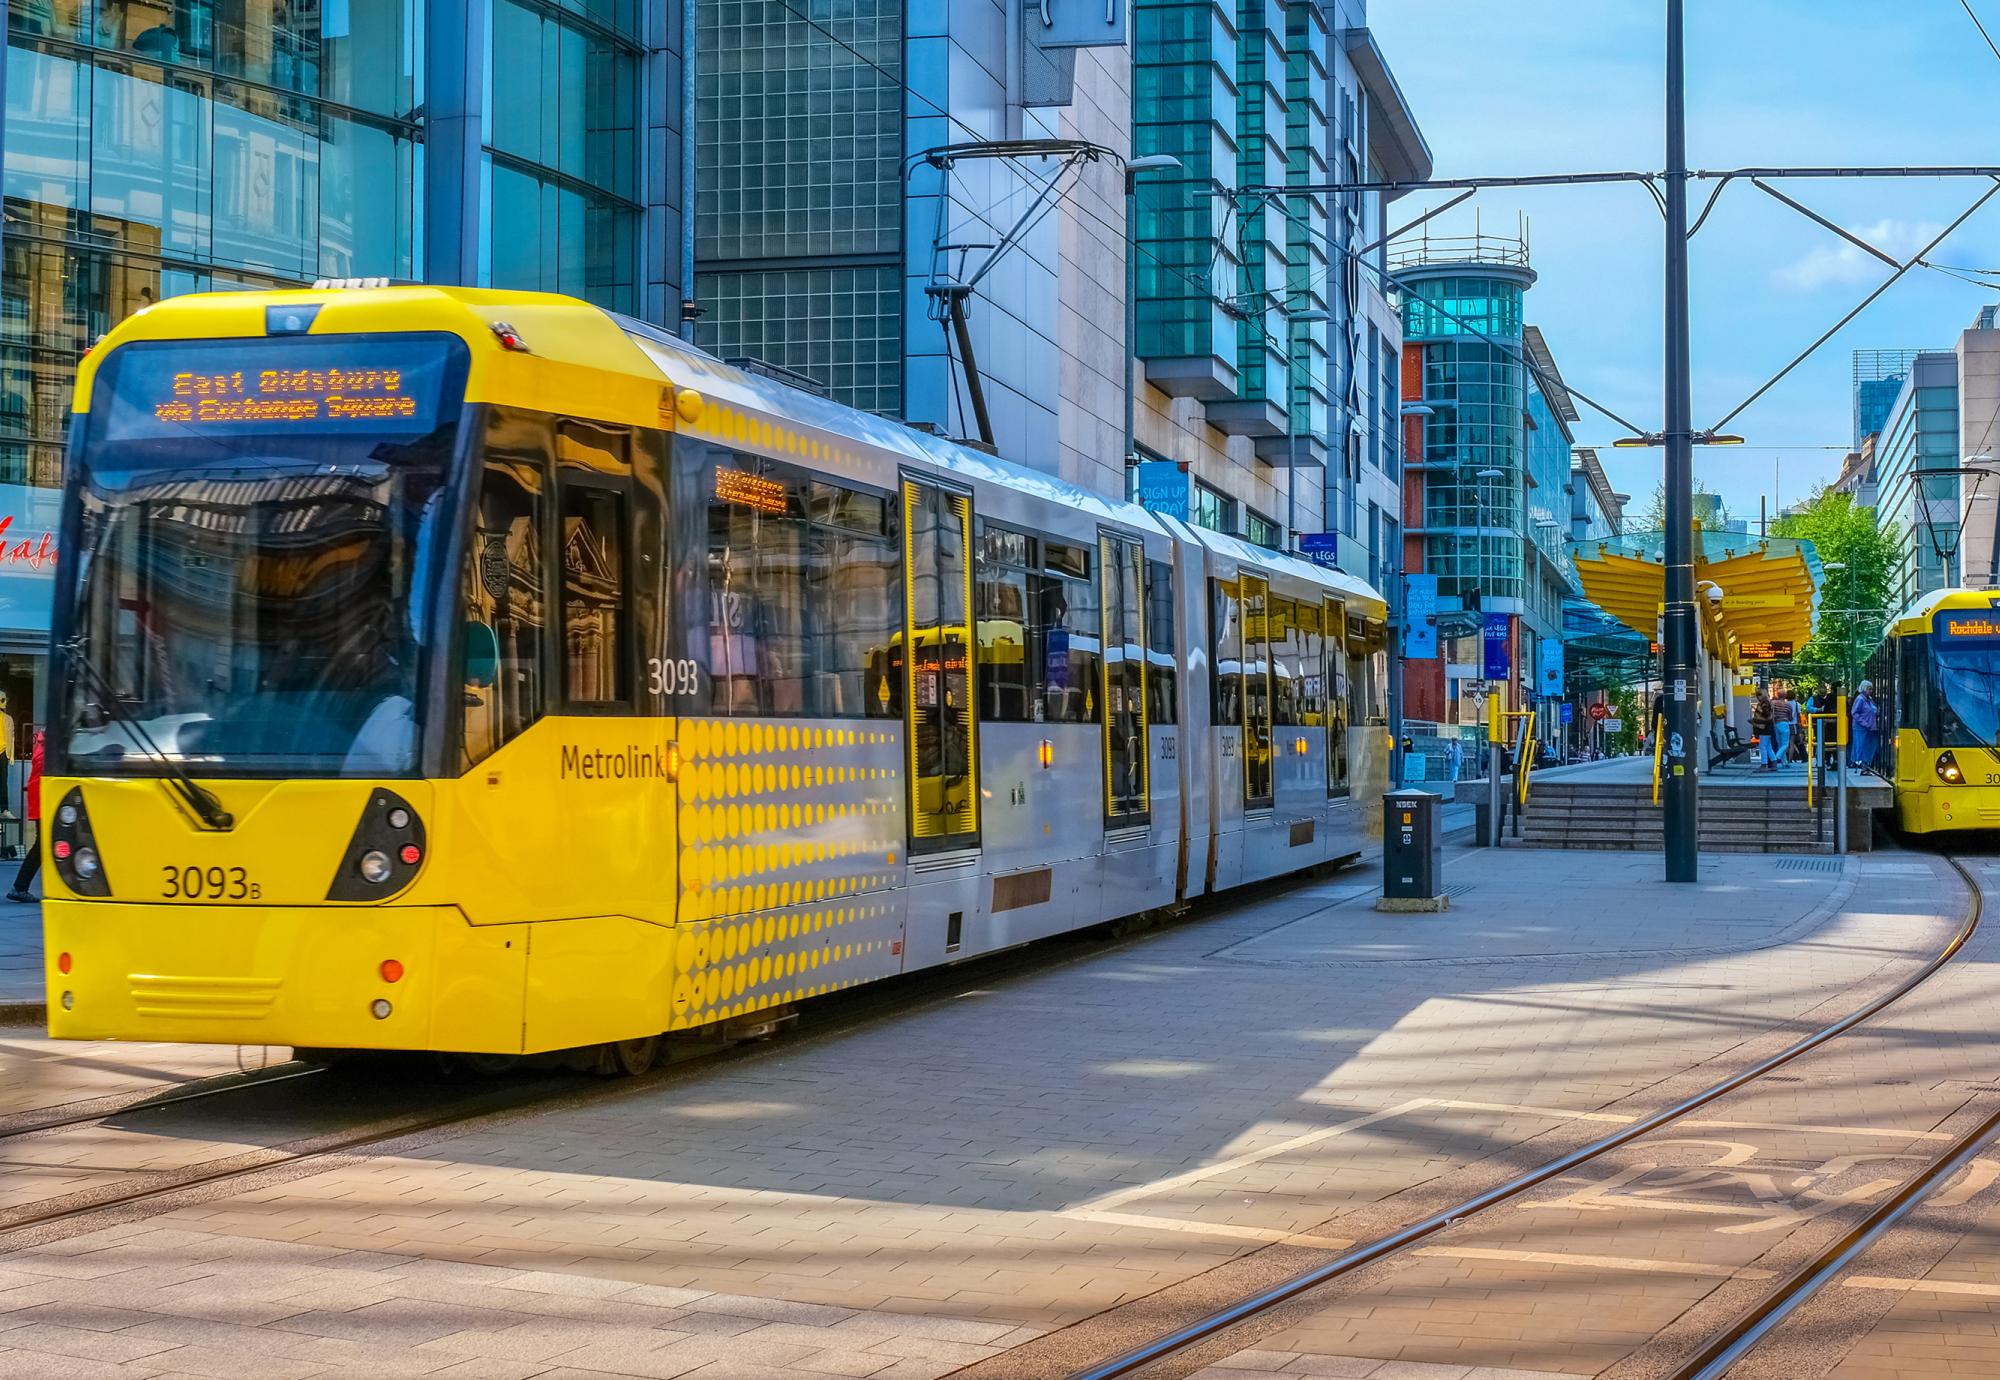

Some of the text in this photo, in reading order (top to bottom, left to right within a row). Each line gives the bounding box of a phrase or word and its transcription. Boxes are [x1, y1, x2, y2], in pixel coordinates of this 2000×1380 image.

[173, 369, 401, 395] East Didsbury
[155, 395, 416, 421] via Exchange Square
[1142, 486, 1187, 500] SIGN UP
[1144, 500, 1187, 515] TODAY
[1949, 620, 1993, 636] Rochdale
[647, 658, 698, 696] 3093
[1160, 736, 1176, 760] 3093
[1221, 735, 1235, 757] 3093
[560, 744, 666, 780] Metrolink
